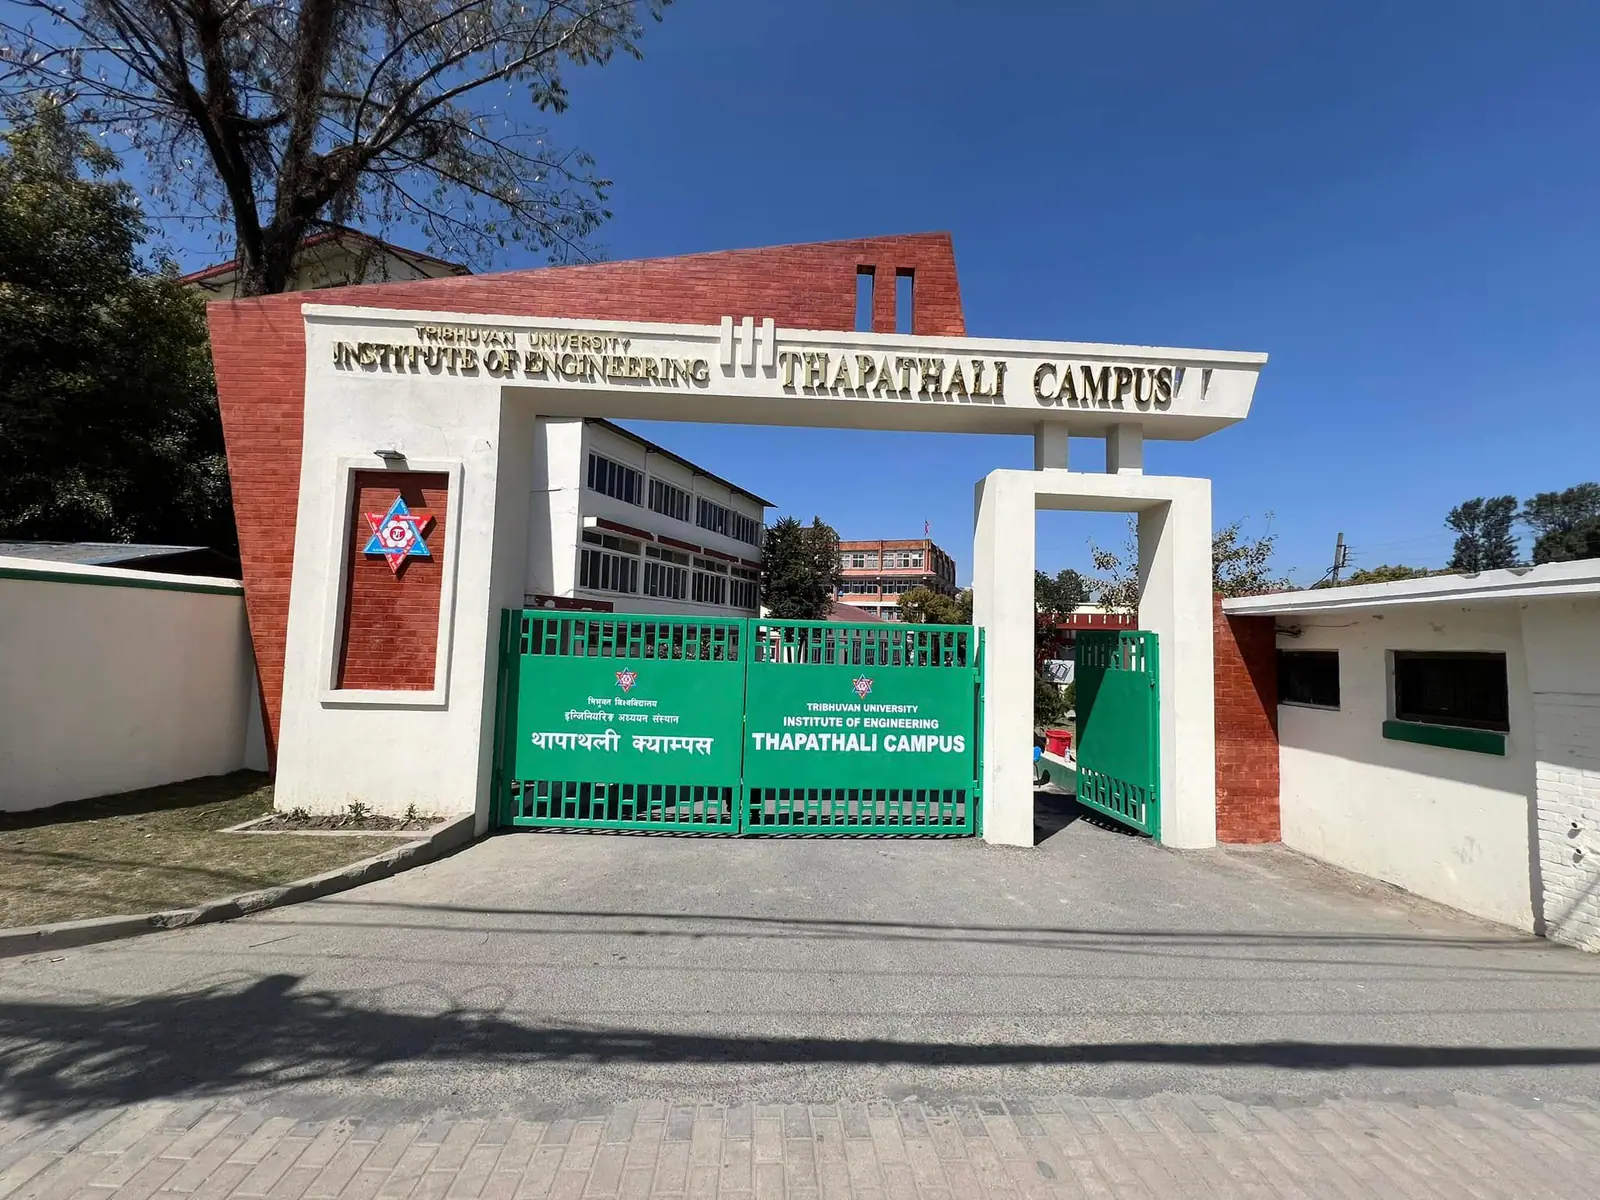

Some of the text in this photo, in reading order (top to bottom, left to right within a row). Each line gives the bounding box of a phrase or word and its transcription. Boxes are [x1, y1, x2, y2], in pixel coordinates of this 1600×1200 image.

[415, 326, 631, 352] TRIBHUVAN UNIVERSITY
[332, 341, 710, 382] INSTITUTE OF ENGINEERING
[780, 350, 1173, 405] THAPATHALI CAMPUS
[618, 713, 649, 723] अध्ययन
[806, 703, 919, 714] TRIBHUVAN UNIVERSITY
[783, 716, 939, 729] INSTITUTE OF ENGINEERING
[531, 728, 715, 756] थापाथली क्याम्पस
[752, 732, 966, 753] THAPATHALI CAMPUS
